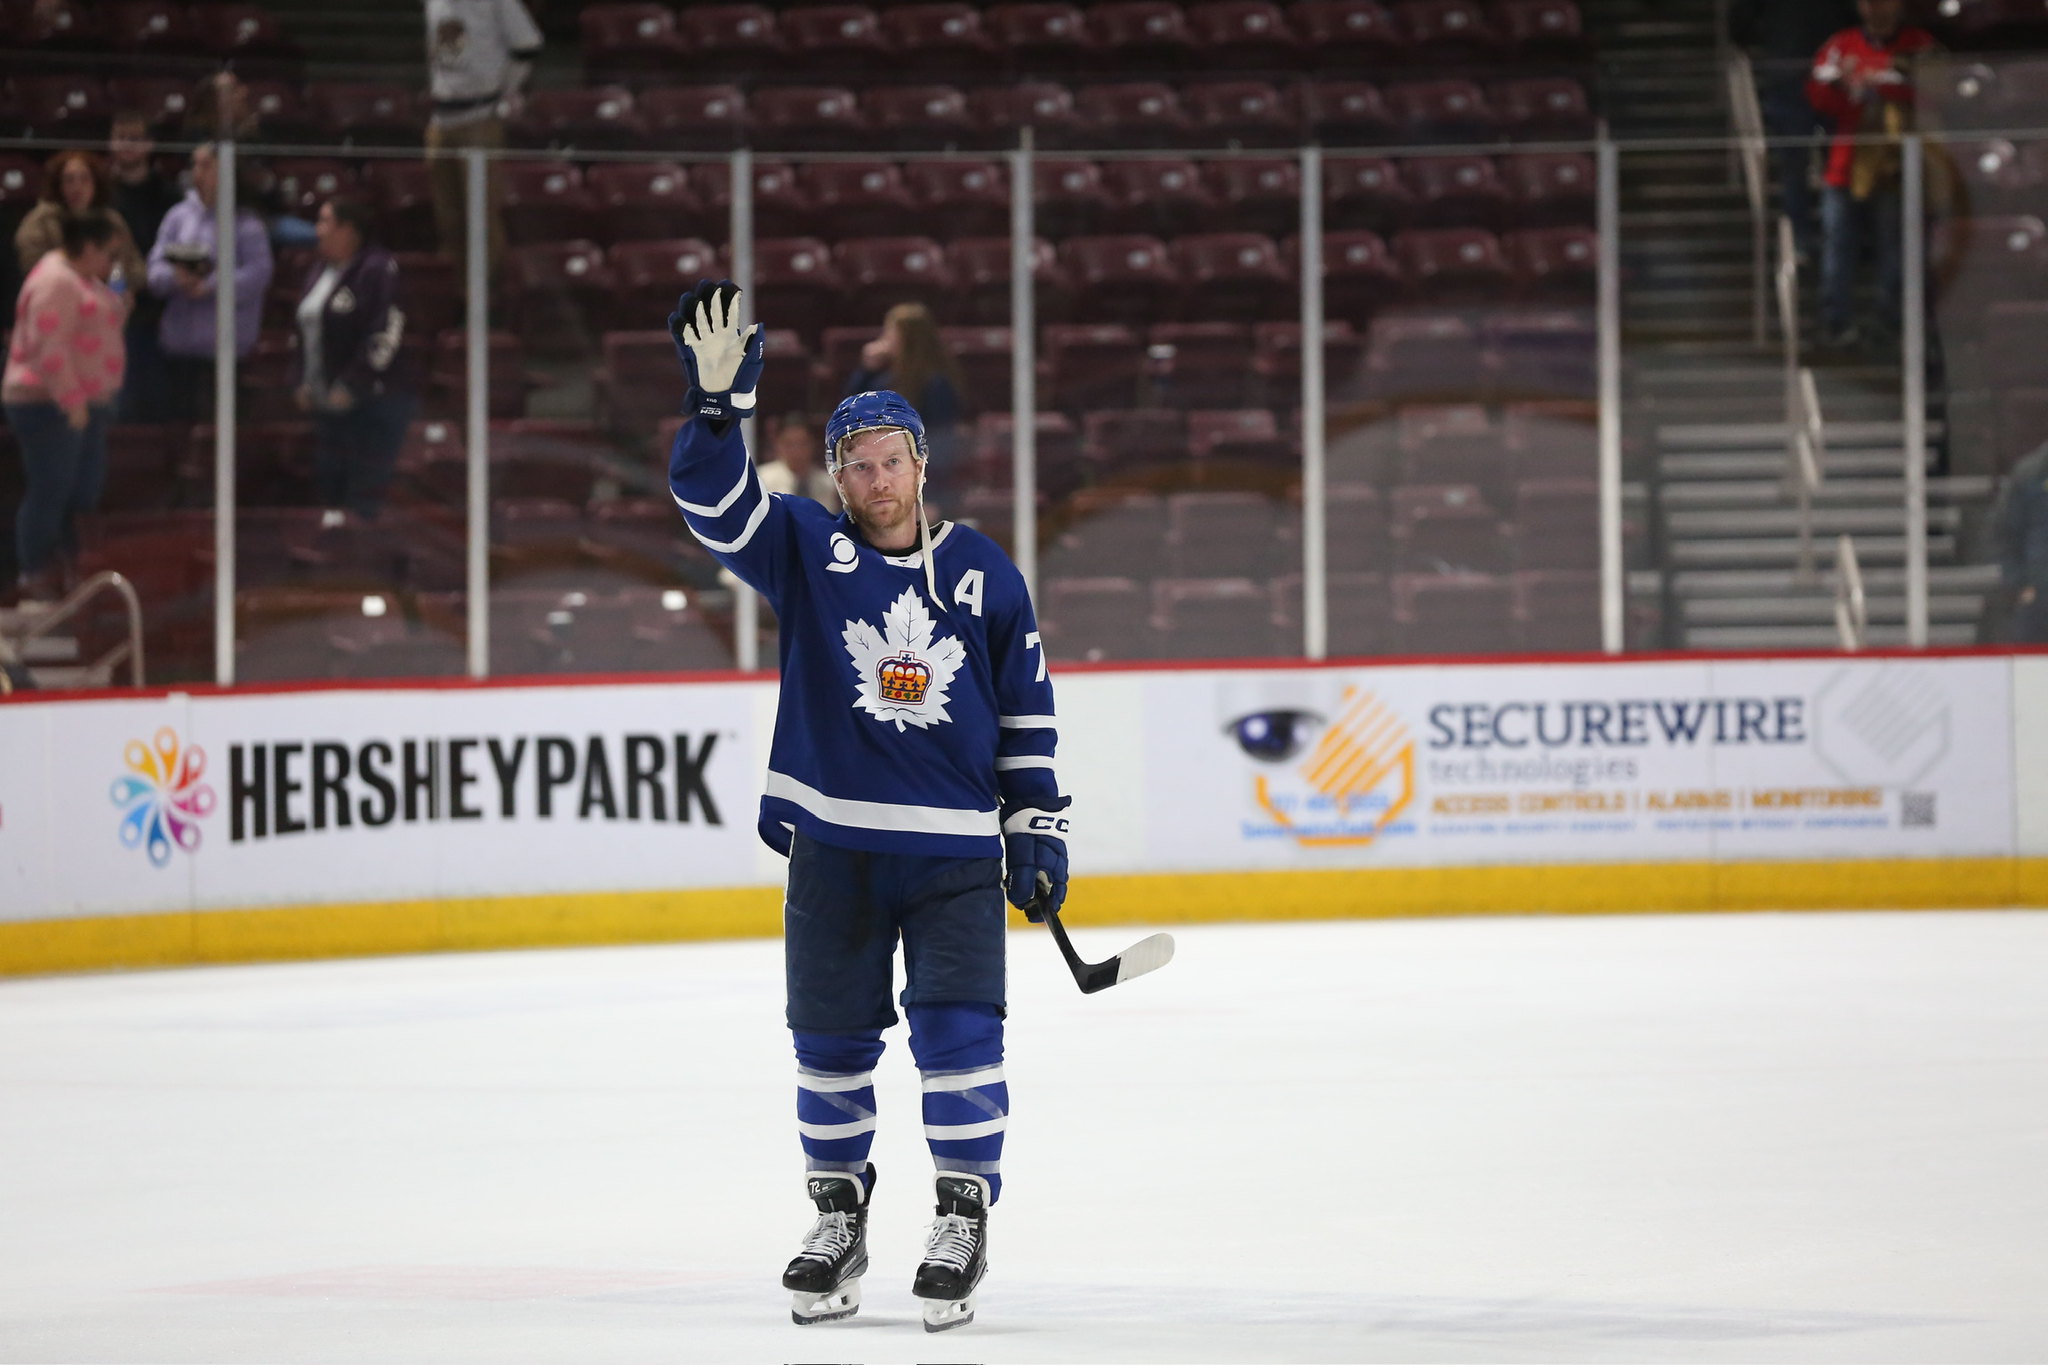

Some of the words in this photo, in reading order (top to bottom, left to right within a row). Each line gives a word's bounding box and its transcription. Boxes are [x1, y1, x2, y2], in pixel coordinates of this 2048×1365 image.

[954, 568, 984, 617] A
[1024, 631, 1047, 682] 7
[1427, 697, 1806, 750] SECUREWIRE
[228, 731, 723, 842] HERSHEYPARK
[1428, 754, 1640, 784] technologies
[808, 1181, 820, 1194] 72
[963, 1182, 979, 1198] 72
